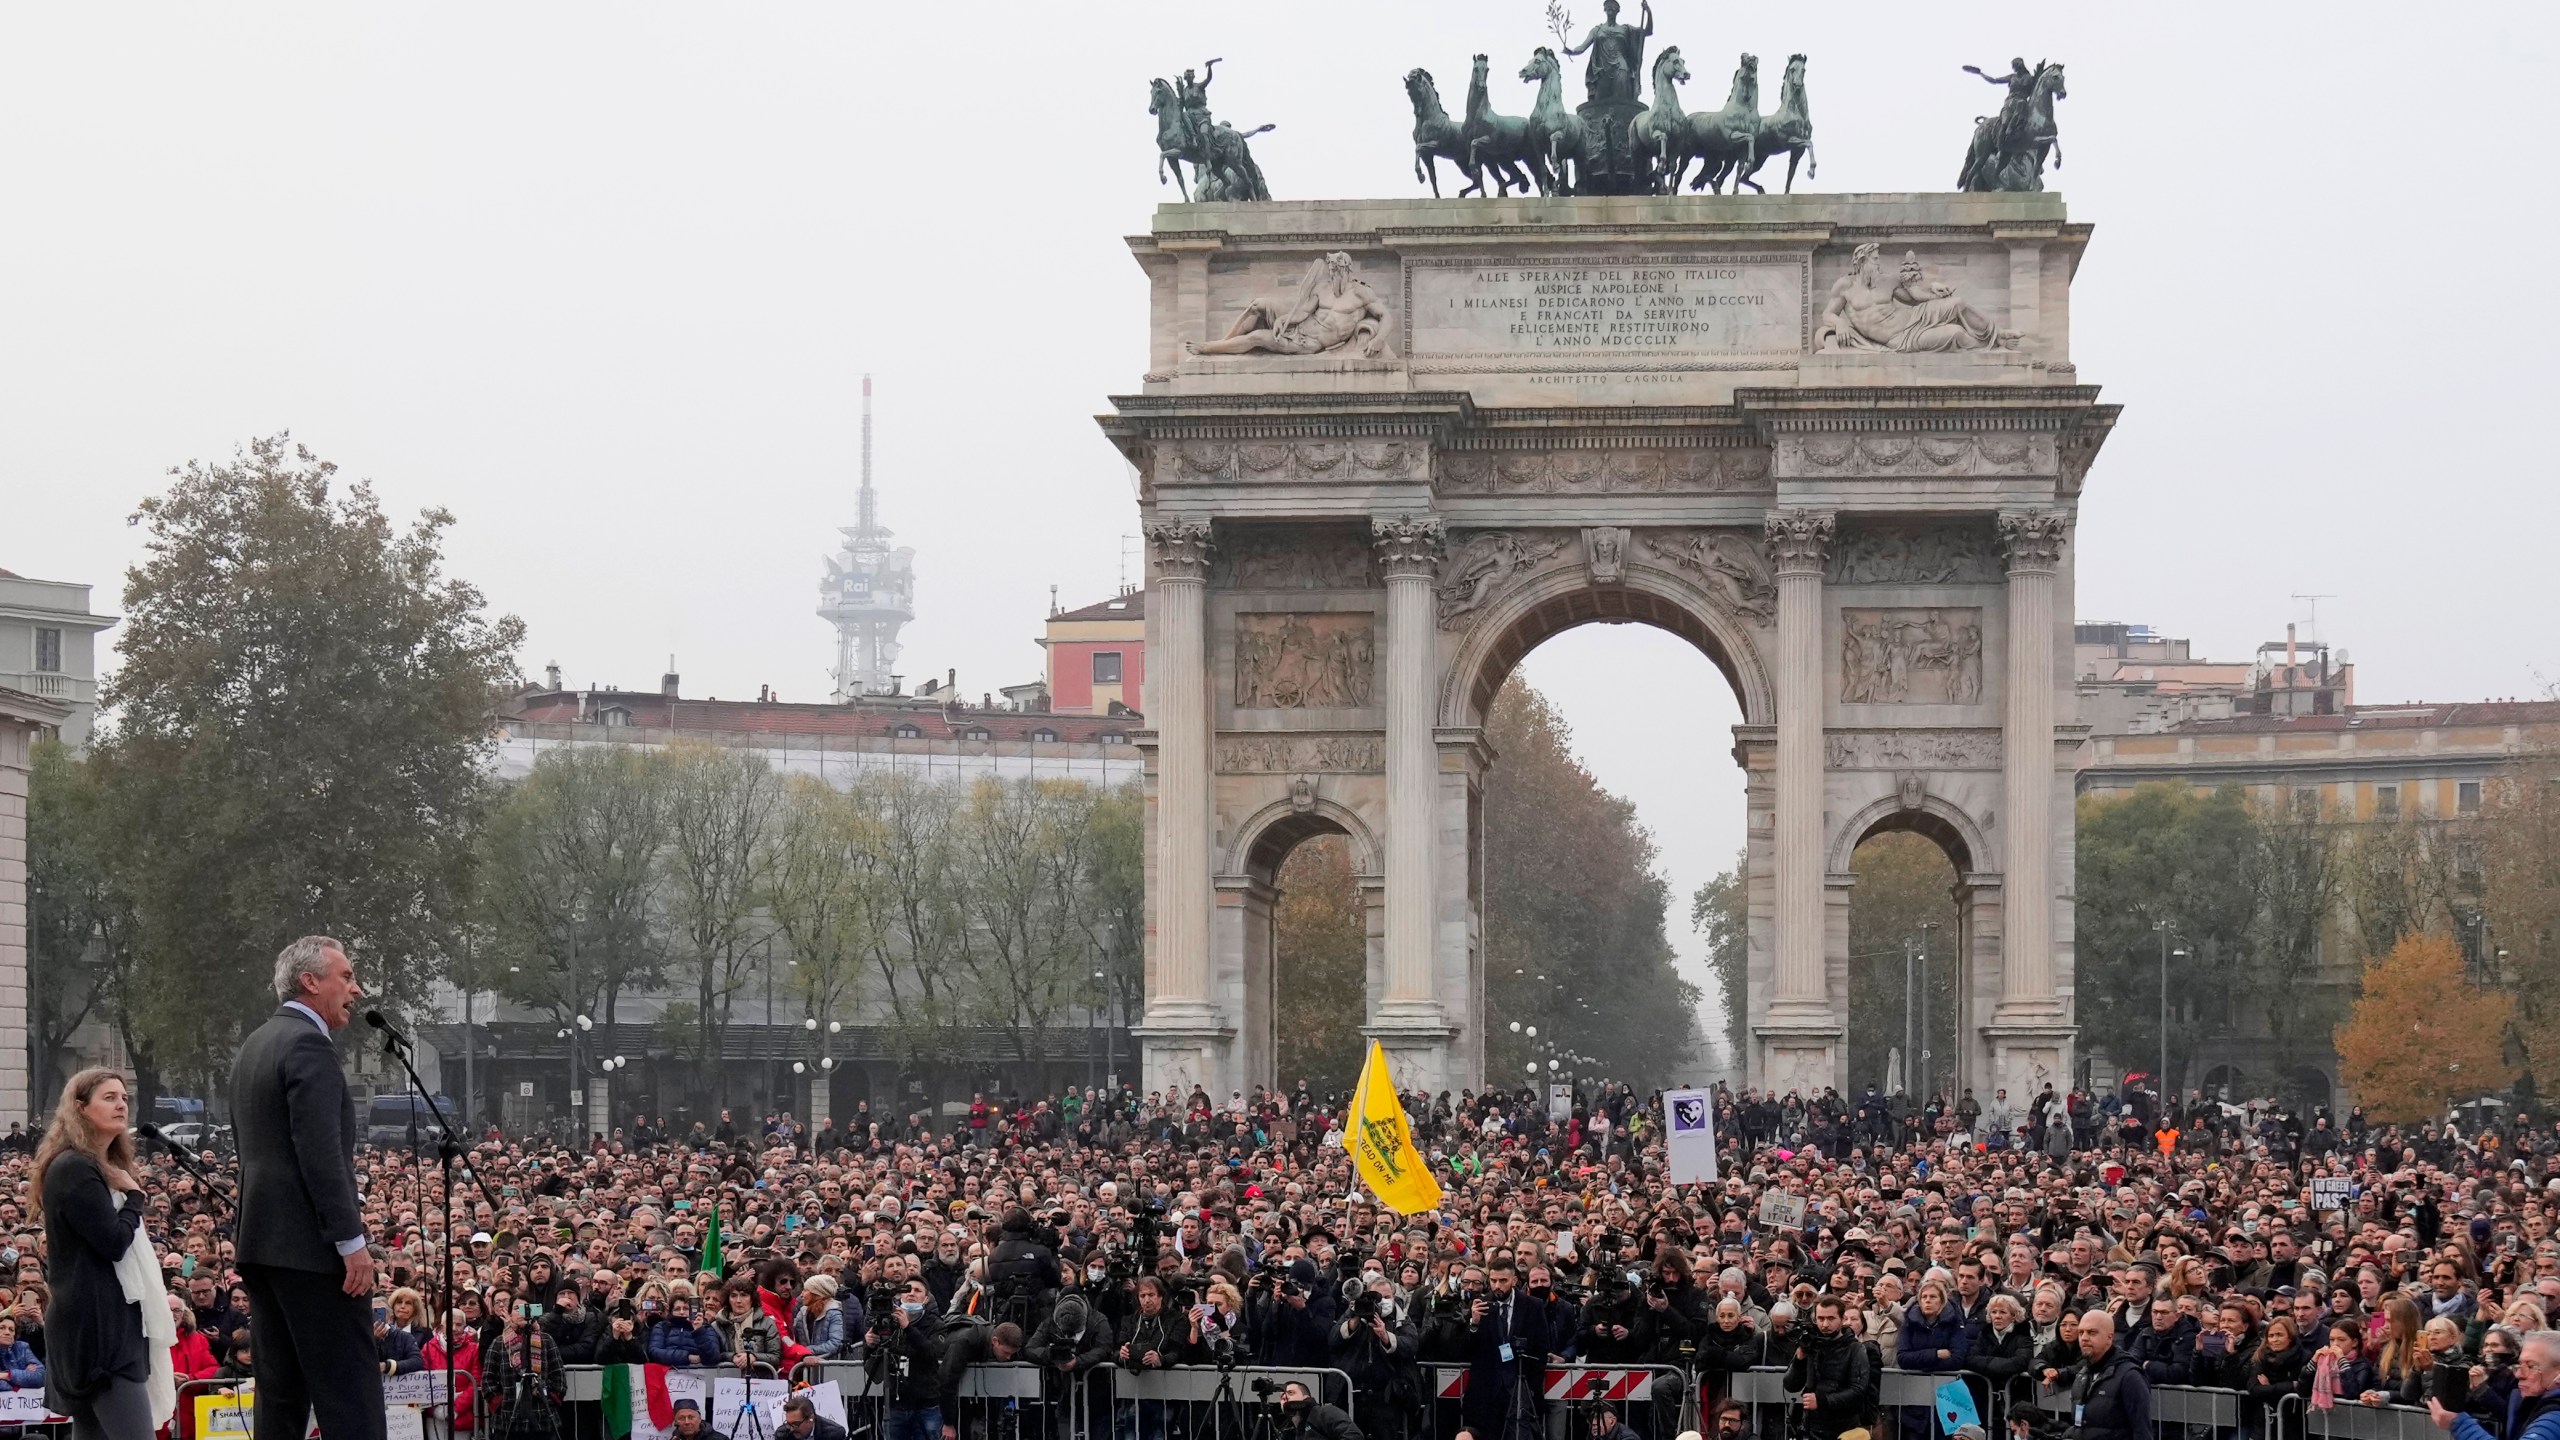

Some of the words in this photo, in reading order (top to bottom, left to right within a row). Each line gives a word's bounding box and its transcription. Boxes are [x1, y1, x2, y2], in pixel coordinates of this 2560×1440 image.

[1477, 272, 1509, 282] ALLE
[1519, 271, 1589, 282] SPERANZE
[1599, 271, 1622, 281] DEL
[1633, 270, 1675, 281] REGNO
[1685, 269, 1737, 280] ITALICO
[1534, 284, 1582, 295] AUSPICE
[1592, 283, 1664, 294] NAPOLEONE
[1464, 298, 1528, 308] MILANESI
[1538, 297, 1625, 308] DEDICARONO
[1649, 297, 1684, 306] ANNO
[1695, 295, 1764, 306] MDCCCVII
[1520, 311, 1526, 321] E
[1537, 311, 1603, 321] FRANCATI
[1616, 310, 1633, 320] DA
[1644, 309, 1697, 319] SERVITU
[1510, 323, 1599, 334] FELICEMENTE
[1610, 322, 1710, 333] RESTITUIRONO
[1553, 336, 1591, 346] ANNO
[1601, 335, 1677, 346] MDCCCLIX
[1529, 375, 1607, 384] ARCHITETTO
[1625, 374, 1683, 383] CAGNOLA
[843, 579, 869, 593] Rai
[1373, 1161, 1385, 1173] ON
[1383, 1173, 1395, 1186] ME
[2315, 1181, 2325, 1192] NO
[2326, 1181, 2349, 1192] GREEN
[1773, 1204, 1792, 1215] FOR
[1768, 1212, 1796, 1223] ITALY
[17, 1396, 44, 1409] TRUST
